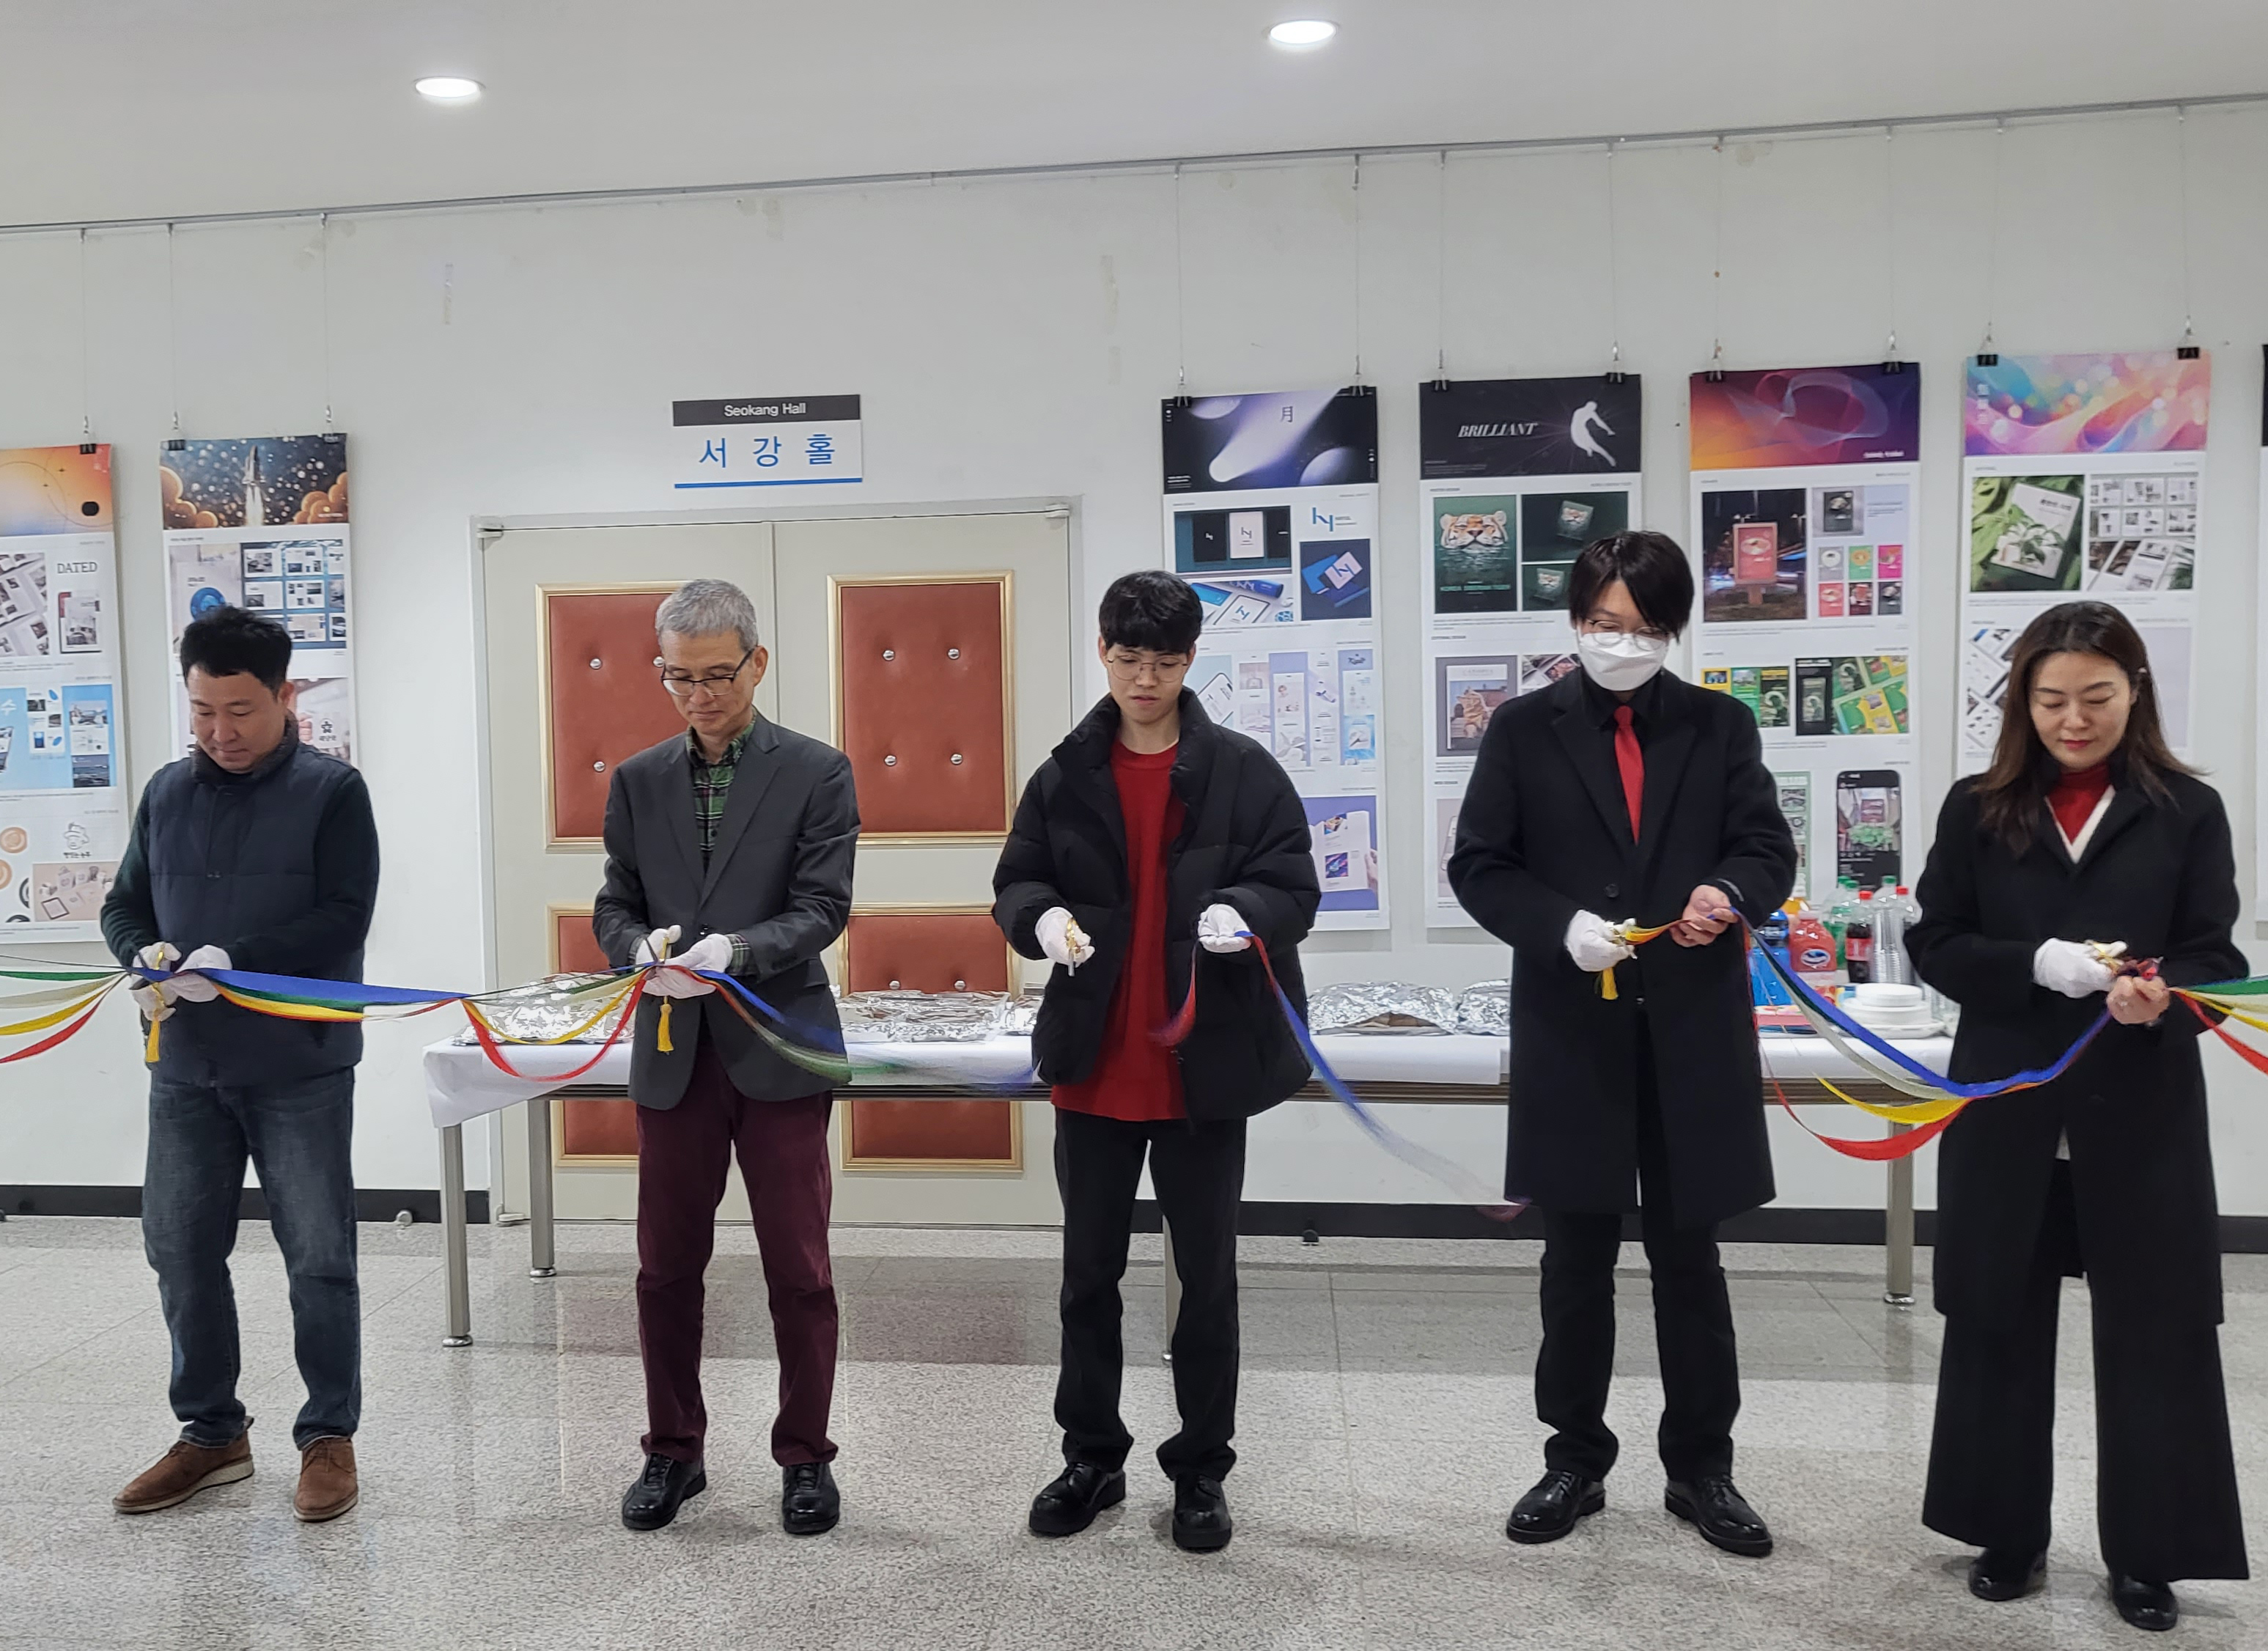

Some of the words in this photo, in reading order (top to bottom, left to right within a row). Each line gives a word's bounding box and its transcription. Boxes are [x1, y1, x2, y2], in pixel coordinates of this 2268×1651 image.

[724, 403, 779, 417] Seokang
[782, 402, 806, 414] Hall
[1280, 405, 1293, 423] 月
[1457, 422, 1539, 438] BRILLIANT
[57, 562, 98, 574] DATED
